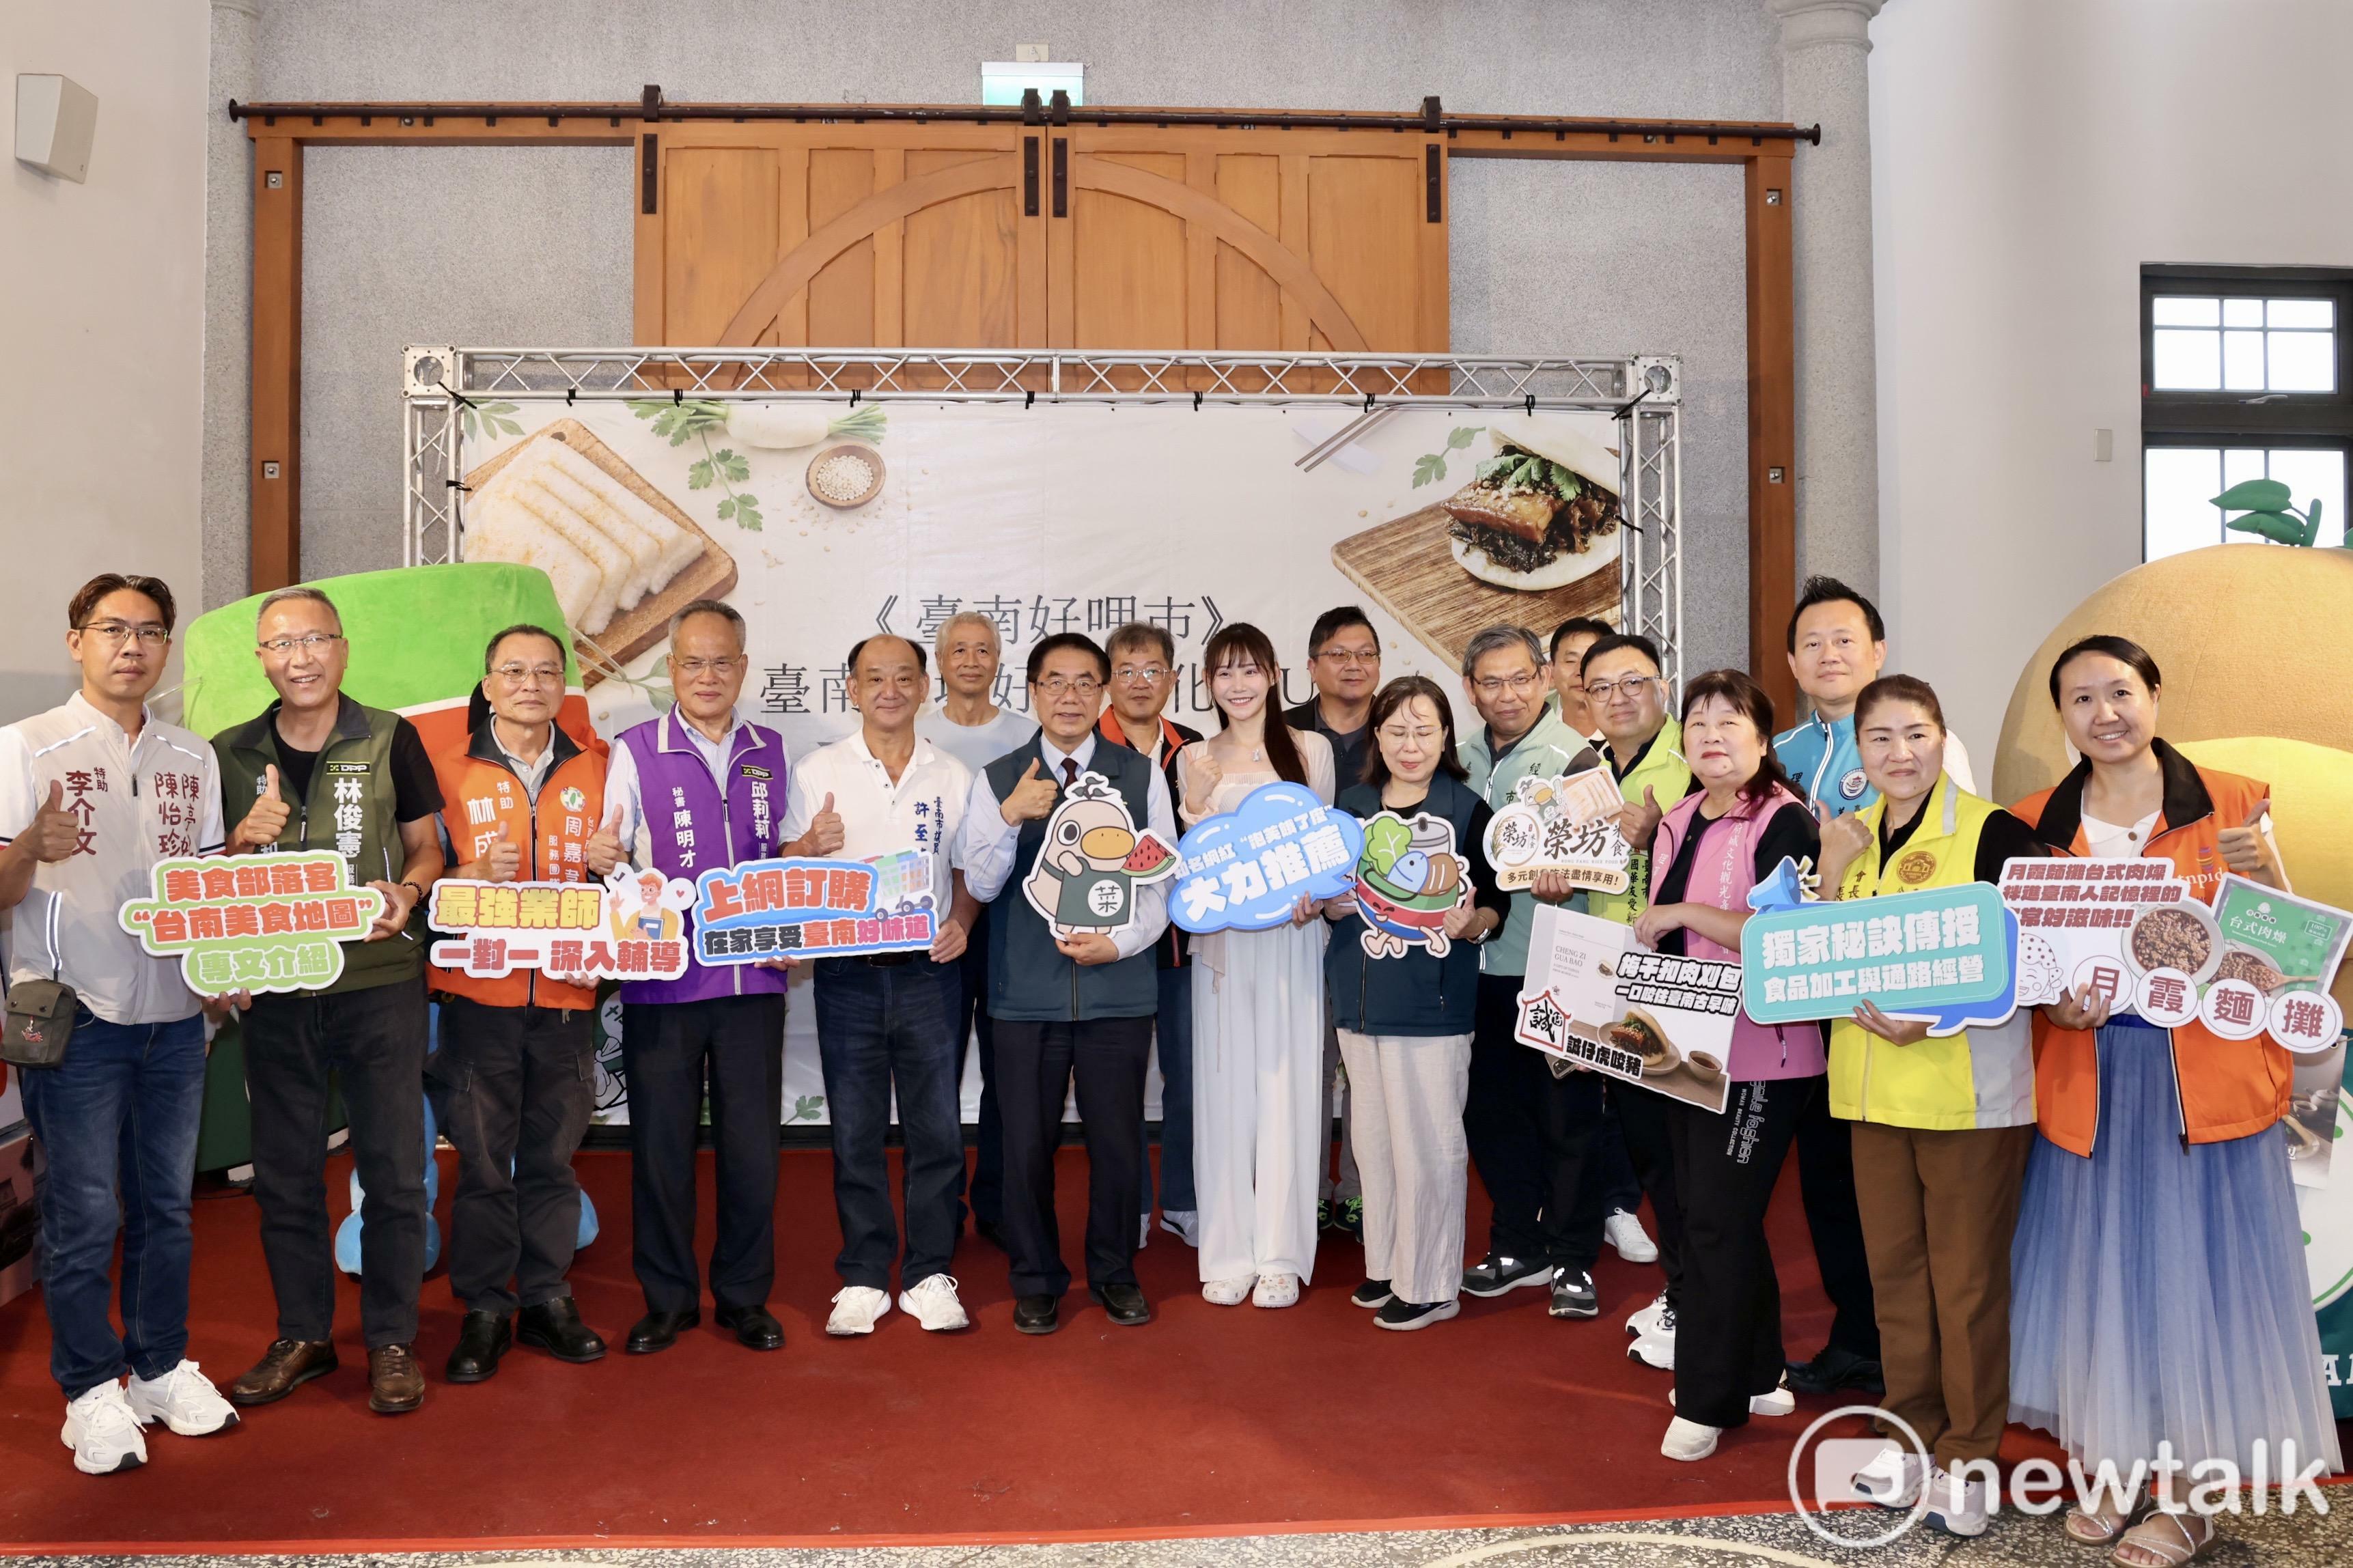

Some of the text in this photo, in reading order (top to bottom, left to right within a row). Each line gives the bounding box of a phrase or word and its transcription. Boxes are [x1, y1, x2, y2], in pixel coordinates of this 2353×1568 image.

[94, 767, 108, 792] 特助
[497, 781, 514, 809] 特助
[66, 770, 97, 855] 李介文
[154, 772, 181, 857] 陳怡珍
[333, 777, 363, 858] 林俊憲
[672, 787, 696, 868] 秘書 陳明才
[751, 781, 770, 839] 邱莉莉
[914, 801, 930, 852] 許至
[1503, 821, 1528, 848] 榮坊
[1544, 818, 1610, 860] 榮坊
[1611, 824, 1626, 856] 米食
[165, 862, 337, 902] 美食部落客
[1180, 824, 1351, 922] 大力推薦
[435, 885, 601, 930] 最強業師
[704, 868, 871, 922] 上網訂購
[1095, 885, 1120, 913] 菜
[133, 898, 373, 942] “台南美食地圖”
[704, 915, 930, 955] 在家享受臺南好味道
[1762, 904, 1981, 969] 獨家秘訣傳授
[2229, 915, 2287, 944] 台式肉燥
[198, 942, 331, 983] 專文介紹
[438, 938, 681, 972] 一對一 深入輔導
[1555, 953, 1583, 967] GUA BAO
[1556, 945, 1578, 957] CHENG
[1617, 953, 1742, 991] 梅干扣肉刈包
[1764, 954, 1984, 1003] 食品加工與通路經營
[2090, 966, 2325, 1038] 月霞麵攤
[1566, 1035, 1642, 1076] 誠仔虎咬豬
[1727, 1089, 1747, 1156] WOMAN BEAUTY COLLECTION
